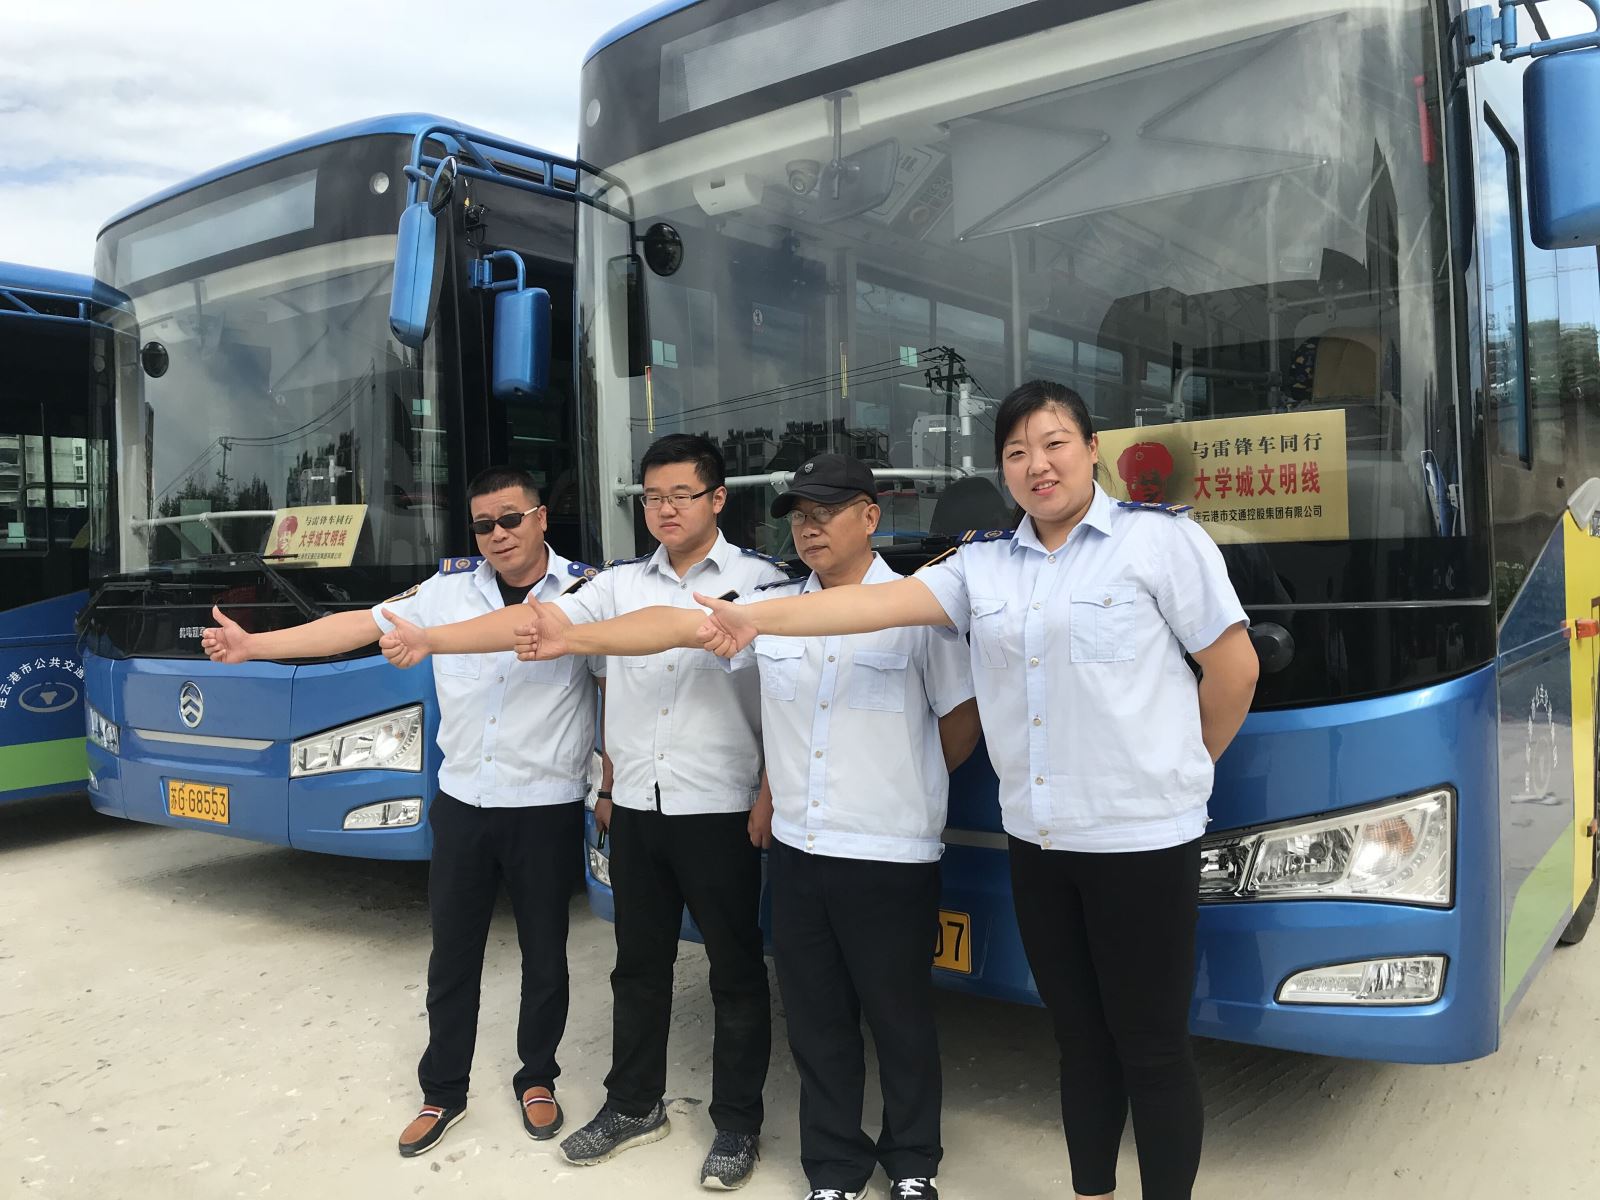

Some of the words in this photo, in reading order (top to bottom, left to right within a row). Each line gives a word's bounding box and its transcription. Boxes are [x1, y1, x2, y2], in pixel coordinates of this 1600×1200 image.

[1192, 432, 1323, 459] 与雷锋车同行
[1193, 461, 1321, 501] 大学城文明线
[1193, 505, 1322, 523] 连云港市交通控股集团有限公司
